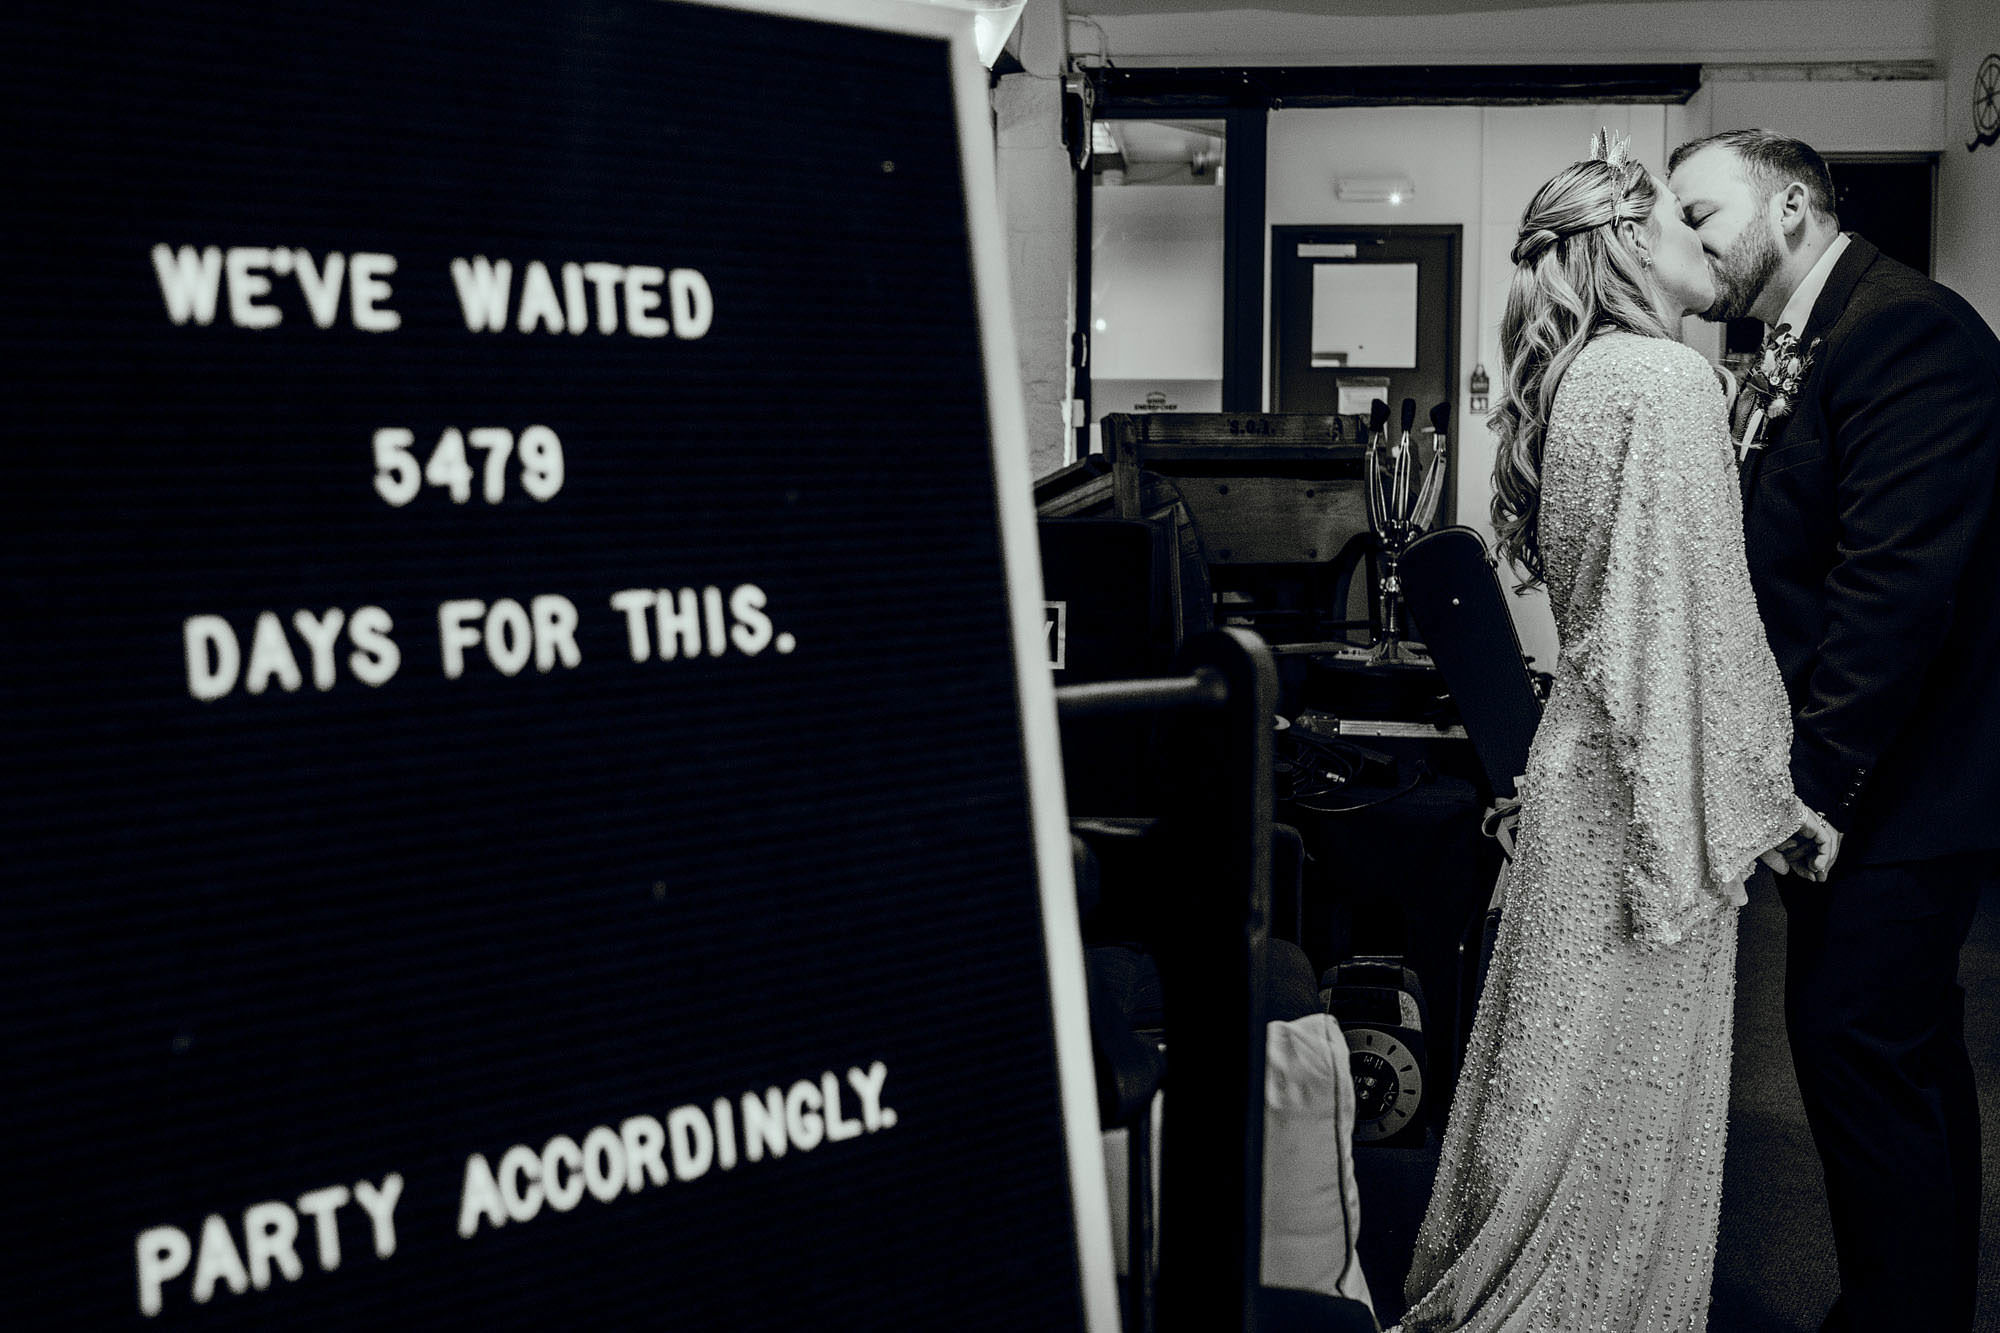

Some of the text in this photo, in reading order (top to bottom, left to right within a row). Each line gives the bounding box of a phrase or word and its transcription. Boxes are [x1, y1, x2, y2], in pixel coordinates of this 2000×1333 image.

[152, 244, 714, 340] WE'VE WAITED
[373, 424, 565, 506] 5479
[184, 583, 797, 700] DAYS FOR THIS.
[136, 1060, 898, 1317] PARTY ACCORDINGLY.
